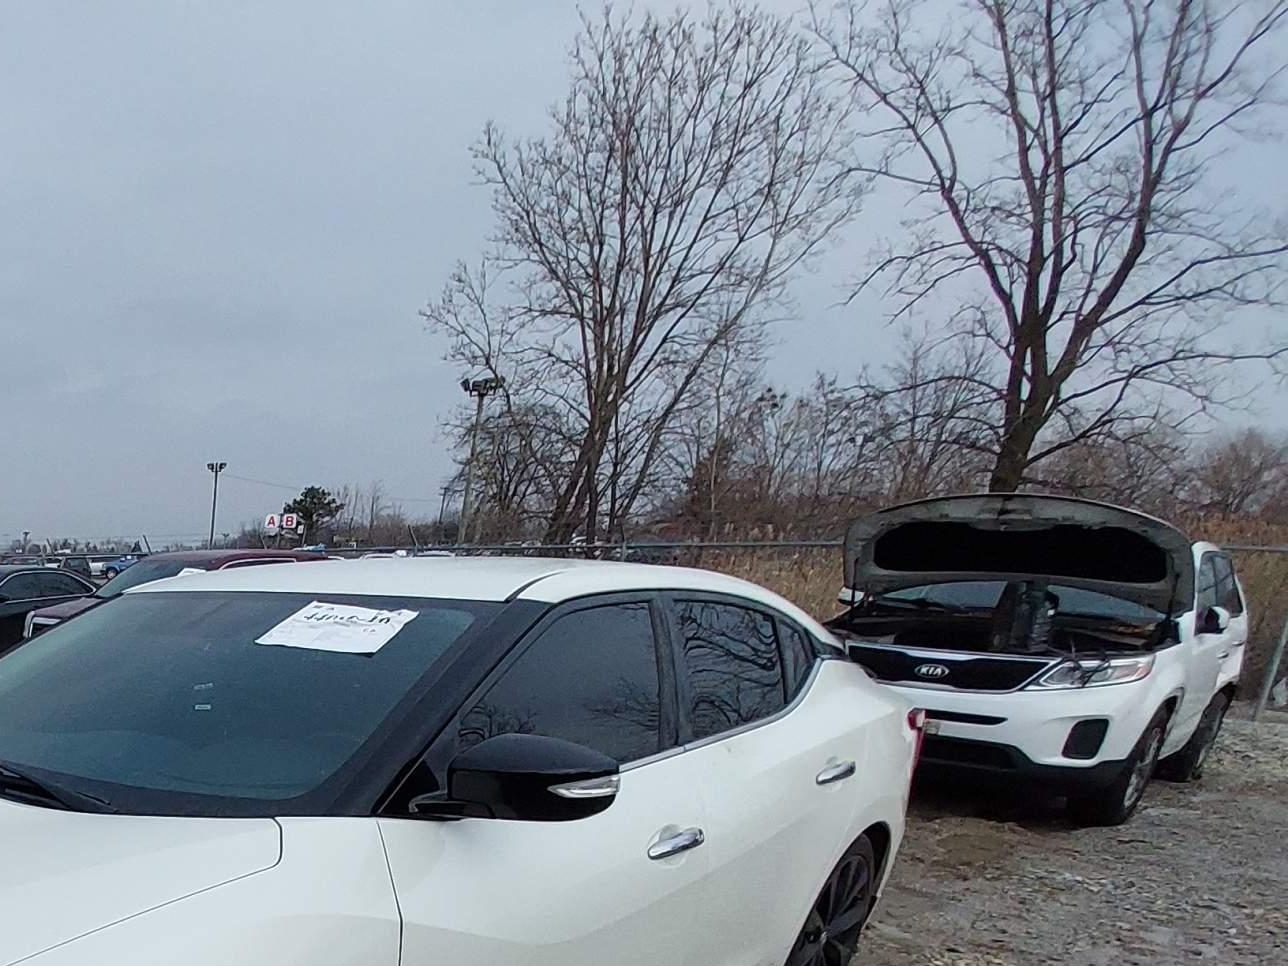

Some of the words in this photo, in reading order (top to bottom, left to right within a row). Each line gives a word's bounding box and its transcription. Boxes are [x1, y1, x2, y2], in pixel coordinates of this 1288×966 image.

[267, 515, 276, 527] A
[285, 515, 294, 527] B
[919, 666, 943, 676] KIA
